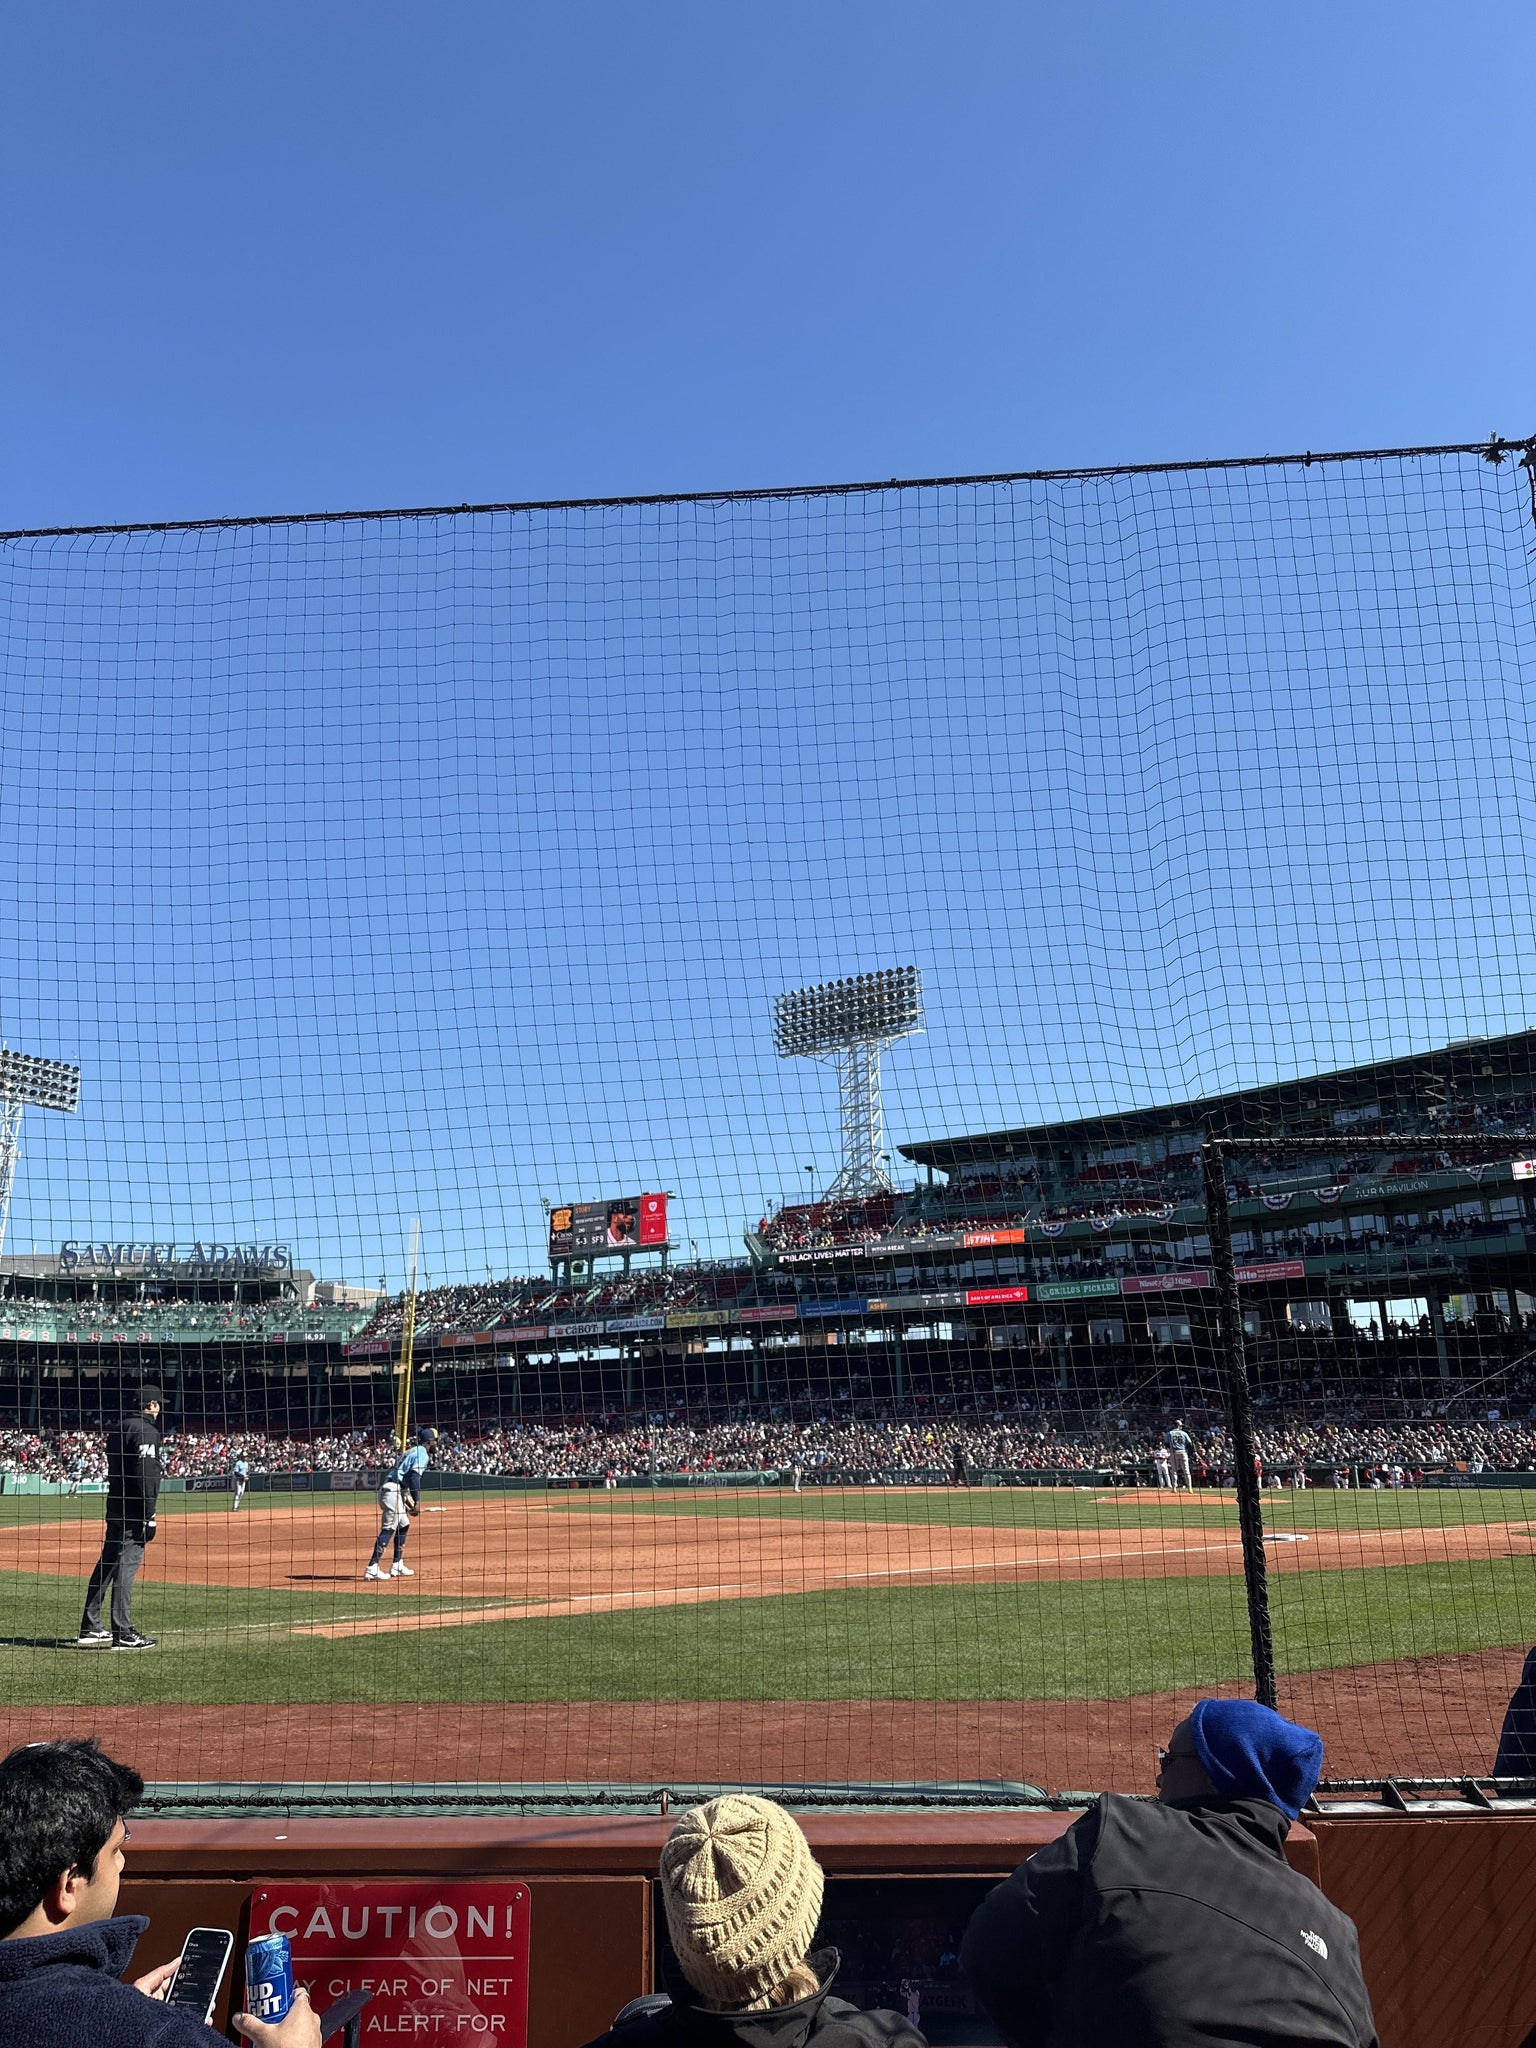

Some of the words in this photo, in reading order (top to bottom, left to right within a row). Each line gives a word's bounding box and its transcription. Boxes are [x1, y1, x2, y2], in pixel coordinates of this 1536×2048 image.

[1387, 1180, 1428, 1194] PAVILION
[575, 1205, 591, 1214] STORY
[592, 1235, 604, 1244] SF9
[967, 1233, 997, 1245] STIHL
[60, 1240, 183, 1269] SAMUEL
[189, 1241, 288, 1270] ADAMS
[790, 1254, 813, 1262] BLACK
[814, 1250, 834, 1260] LIVES
[835, 1248, 863, 1258] MATTER
[1234, 1271, 1257, 1280] elite
[1084, 1283, 1116, 1293] PICKLES
[65, 1332, 78, 1342] 14
[87, 1332, 103, 1342] 45
[161, 1332, 175, 1342] 42
[268, 1905, 513, 1939] CAUTION!
[249, 1983, 273, 2001] UD
[293, 1979, 317, 1993] AY
[329, 1979, 407, 1996] CLEAR
[421, 1979, 454, 1996] OF
[468, 1979, 513, 1996] NET
[249, 1995, 282, 2017] GHT
[367, 2014, 444, 2032] ALERT
[457, 2014, 506, 2032] FOR
